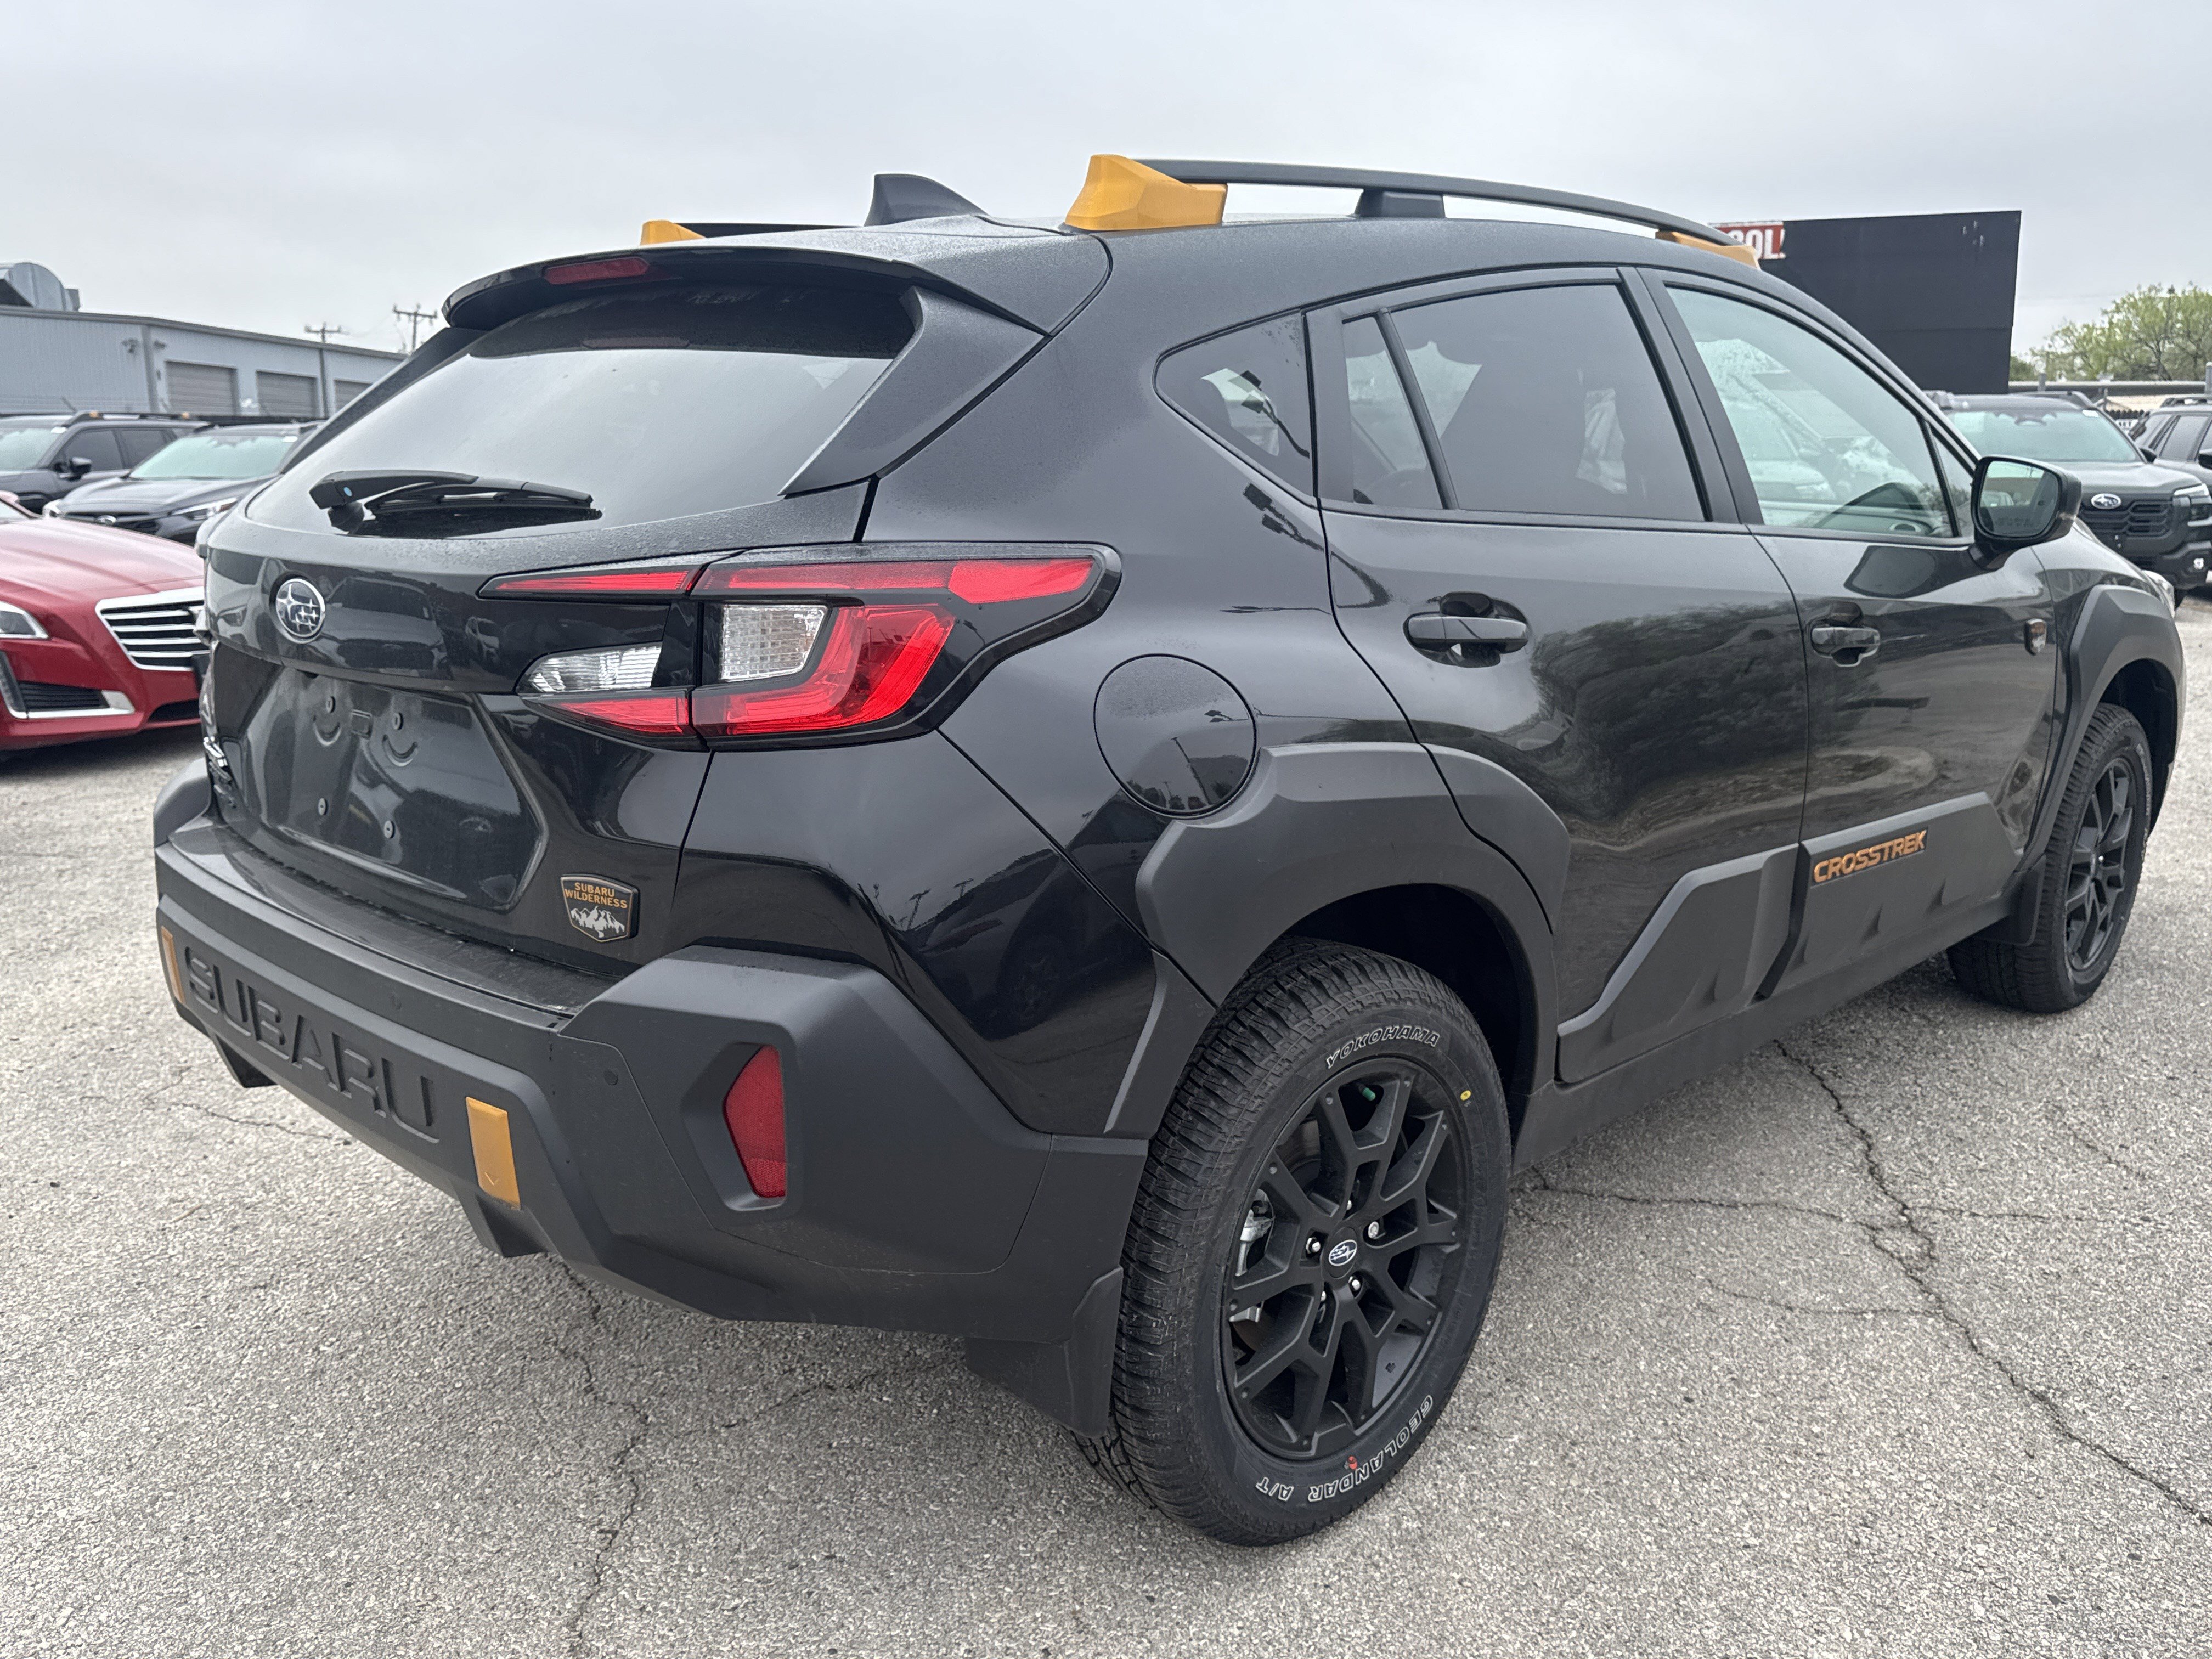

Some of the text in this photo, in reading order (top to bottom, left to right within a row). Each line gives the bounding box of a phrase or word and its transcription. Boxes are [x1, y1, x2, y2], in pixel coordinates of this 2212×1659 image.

[1814, 830, 1927, 883] CROSSTREK
[565, 889, 628, 909] WILDERNESS
[574, 882, 615, 897] SUBARU
[184, 946, 441, 1144] SUBARU
[1325, 1025, 1440, 1068] YOKOHAMA
[1256, 1395, 1433, 1502] GEOLANDAR A/T
